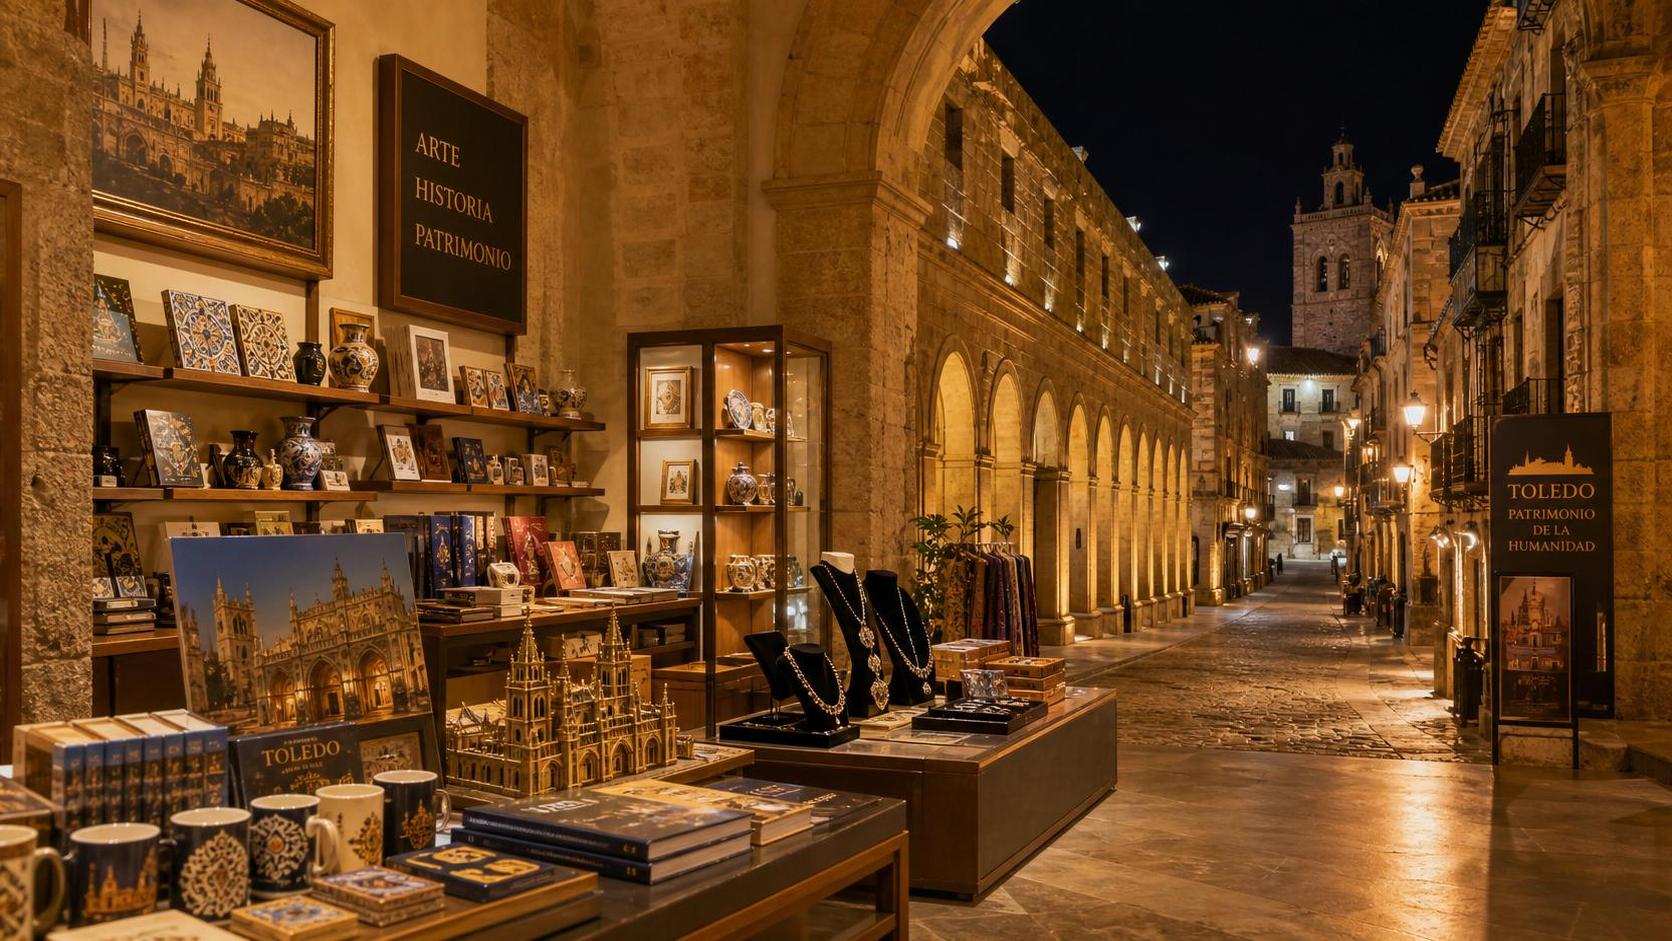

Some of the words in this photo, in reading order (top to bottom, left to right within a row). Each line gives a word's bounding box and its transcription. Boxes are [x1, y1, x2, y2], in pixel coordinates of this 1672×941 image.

[415, 132, 461, 168] ARTE
[415, 177, 493, 224] HISTORIA
[415, 223, 512, 271] PATRIMONIO
[1507, 483, 1595, 499] TOLEDO
[1508, 508, 1596, 520] PATRIMONIO
[1533, 525, 1550, 536] DE
[1554, 525, 1570, 536] LA
[1508, 540, 1596, 552] HUMANIDAD
[261, 740, 341, 767] TOLEDO
